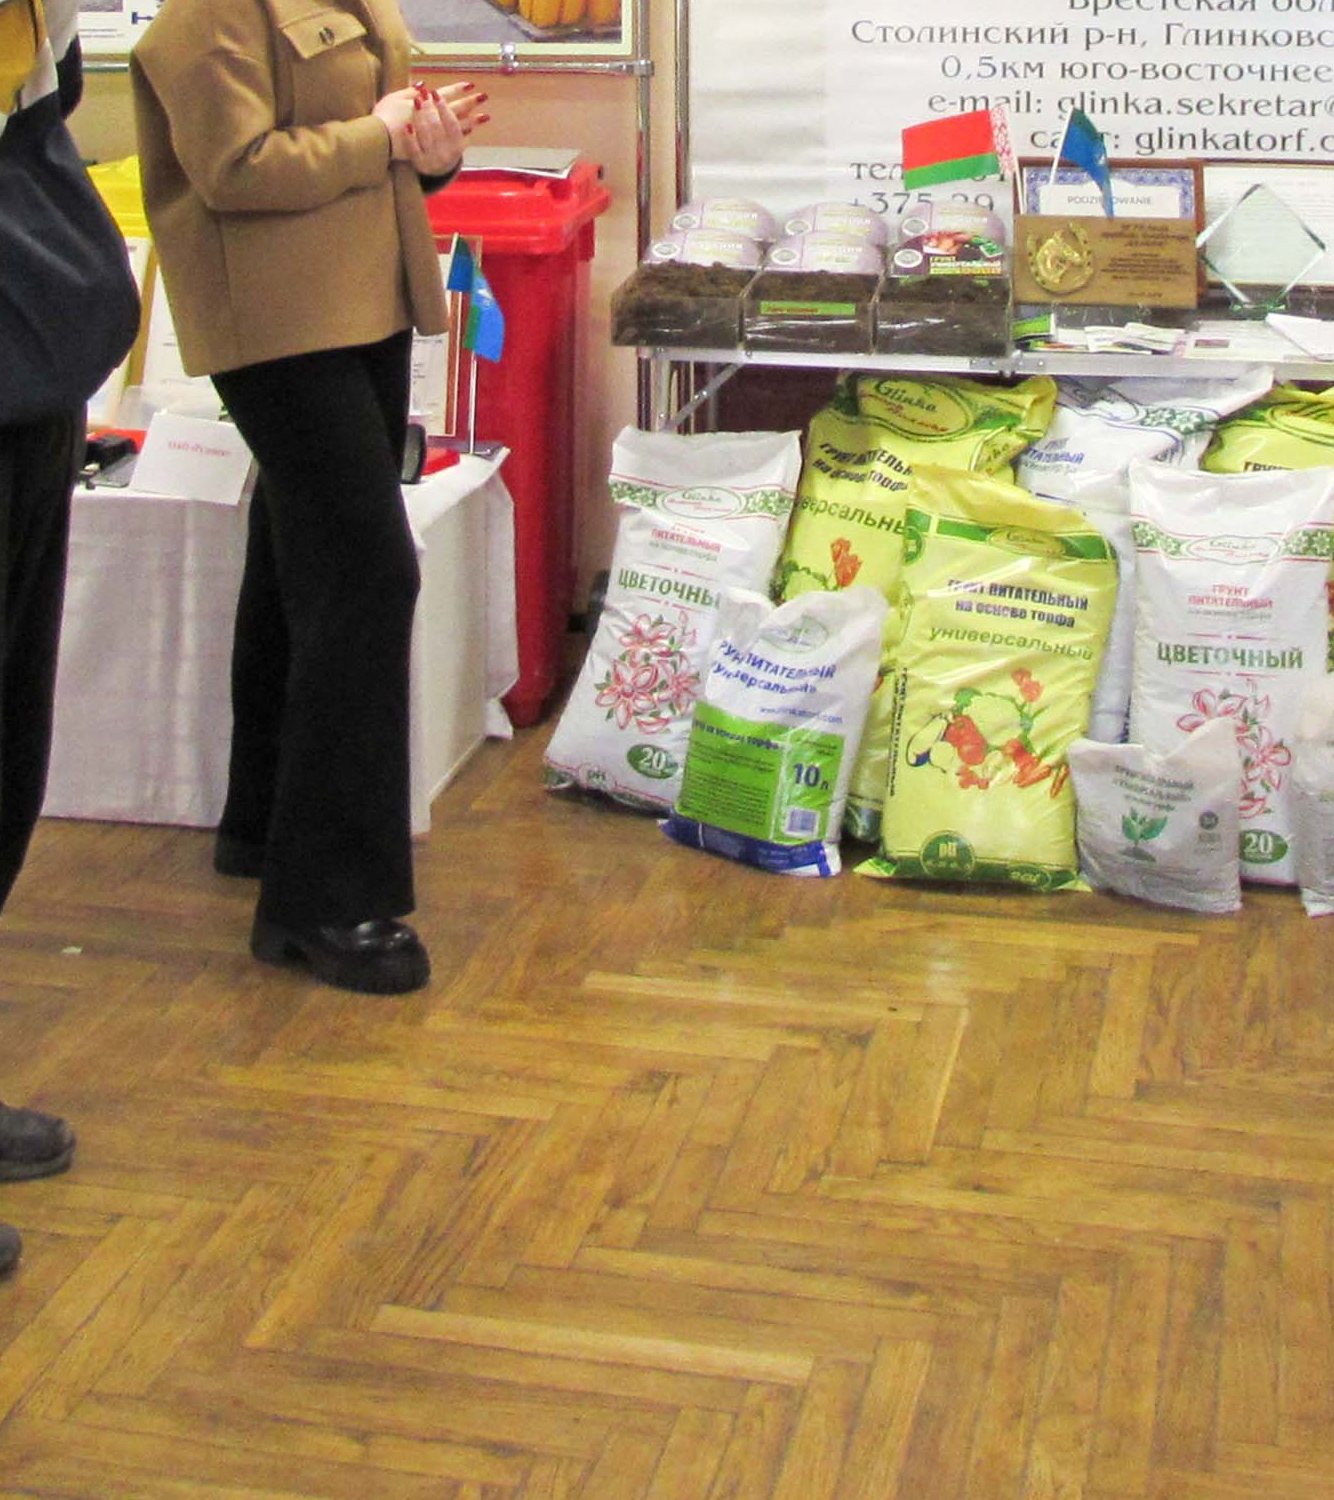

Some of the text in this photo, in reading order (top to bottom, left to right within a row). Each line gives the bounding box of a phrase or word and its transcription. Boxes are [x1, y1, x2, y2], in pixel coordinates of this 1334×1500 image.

[851, 19, 1069, 45] Столинский
[1085, 25, 1148, 51] р-н,
[940, 54, 1045, 80] 0,5км
[1060, 60, 1333, 84] юго-восточнее
[875, 378, 939, 413] Glinka
[618, 567, 722, 609] ЦВЕТОЧНЫ
[988, 582, 1088, 611] ПИТАТЕЛЬНЫЙ
[955, 601, 1075, 629] на основе торфа
[930, 626, 1094, 661] универсальный
[1157, 641, 1303, 669] ЦВЕТОЧНЫЙ
[638, 747, 666, 771] 20
[794, 763, 821, 788] 10
[1244, 833, 1273, 854] 20
